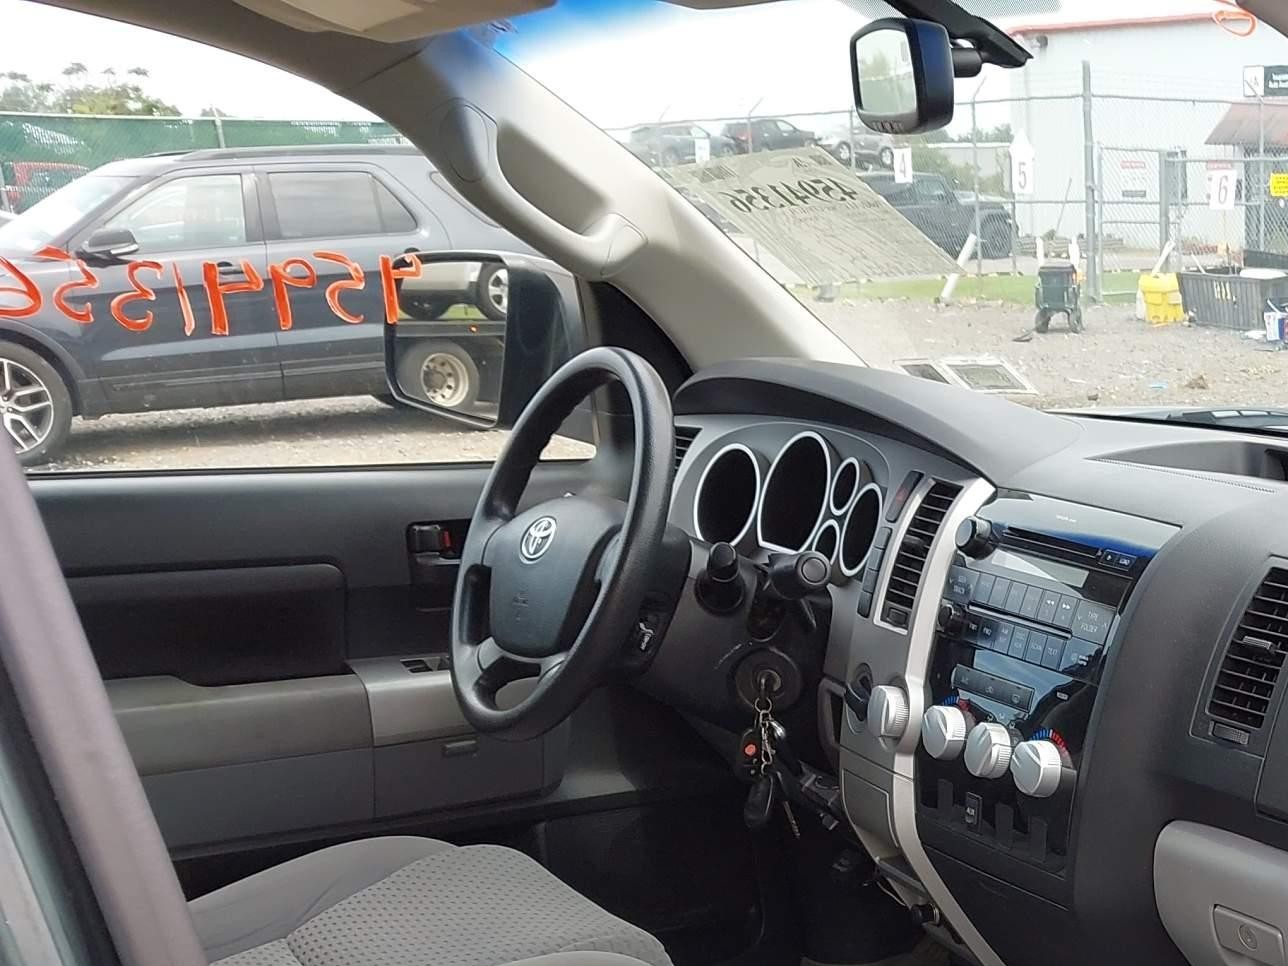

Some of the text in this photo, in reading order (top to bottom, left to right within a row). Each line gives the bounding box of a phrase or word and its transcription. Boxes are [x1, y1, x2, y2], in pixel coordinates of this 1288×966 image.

[898, 152, 907, 179] 4
[1018, 162, 1027, 190] 5
[1218, 175, 1229, 205] 6
